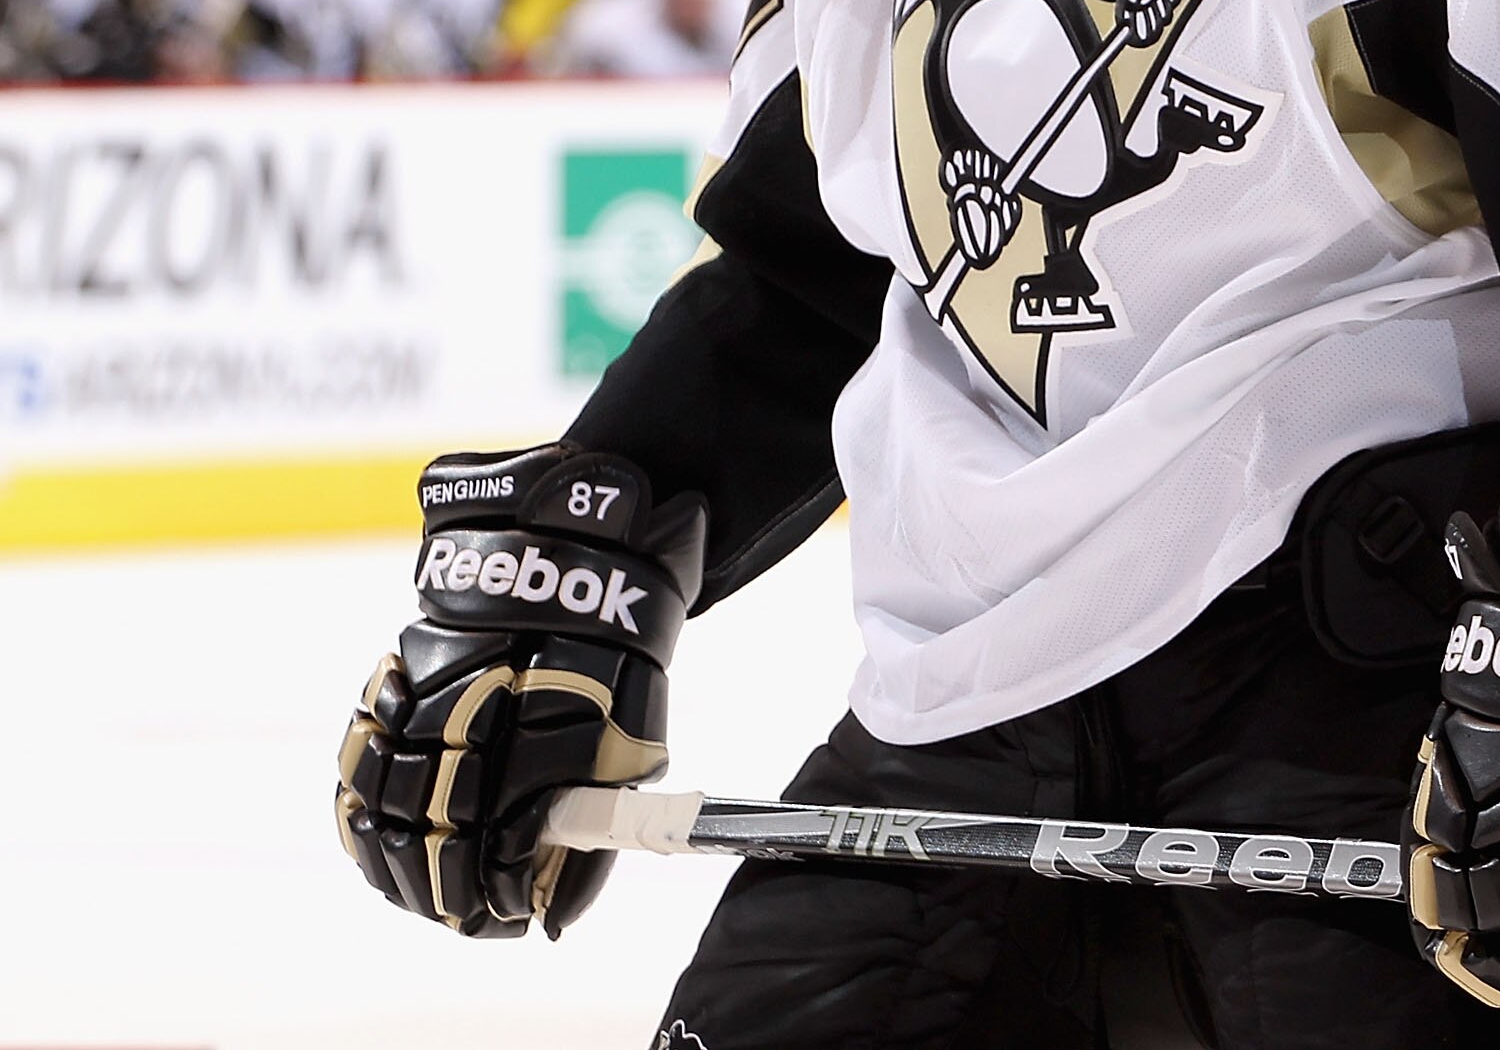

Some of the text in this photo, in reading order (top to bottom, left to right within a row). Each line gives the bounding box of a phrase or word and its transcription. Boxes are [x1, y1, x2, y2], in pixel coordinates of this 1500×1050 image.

[422, 475, 620, 520] PENGUINS 87
[1444, 538, 1463, 580] 7
[417, 536, 648, 634] Reebok
